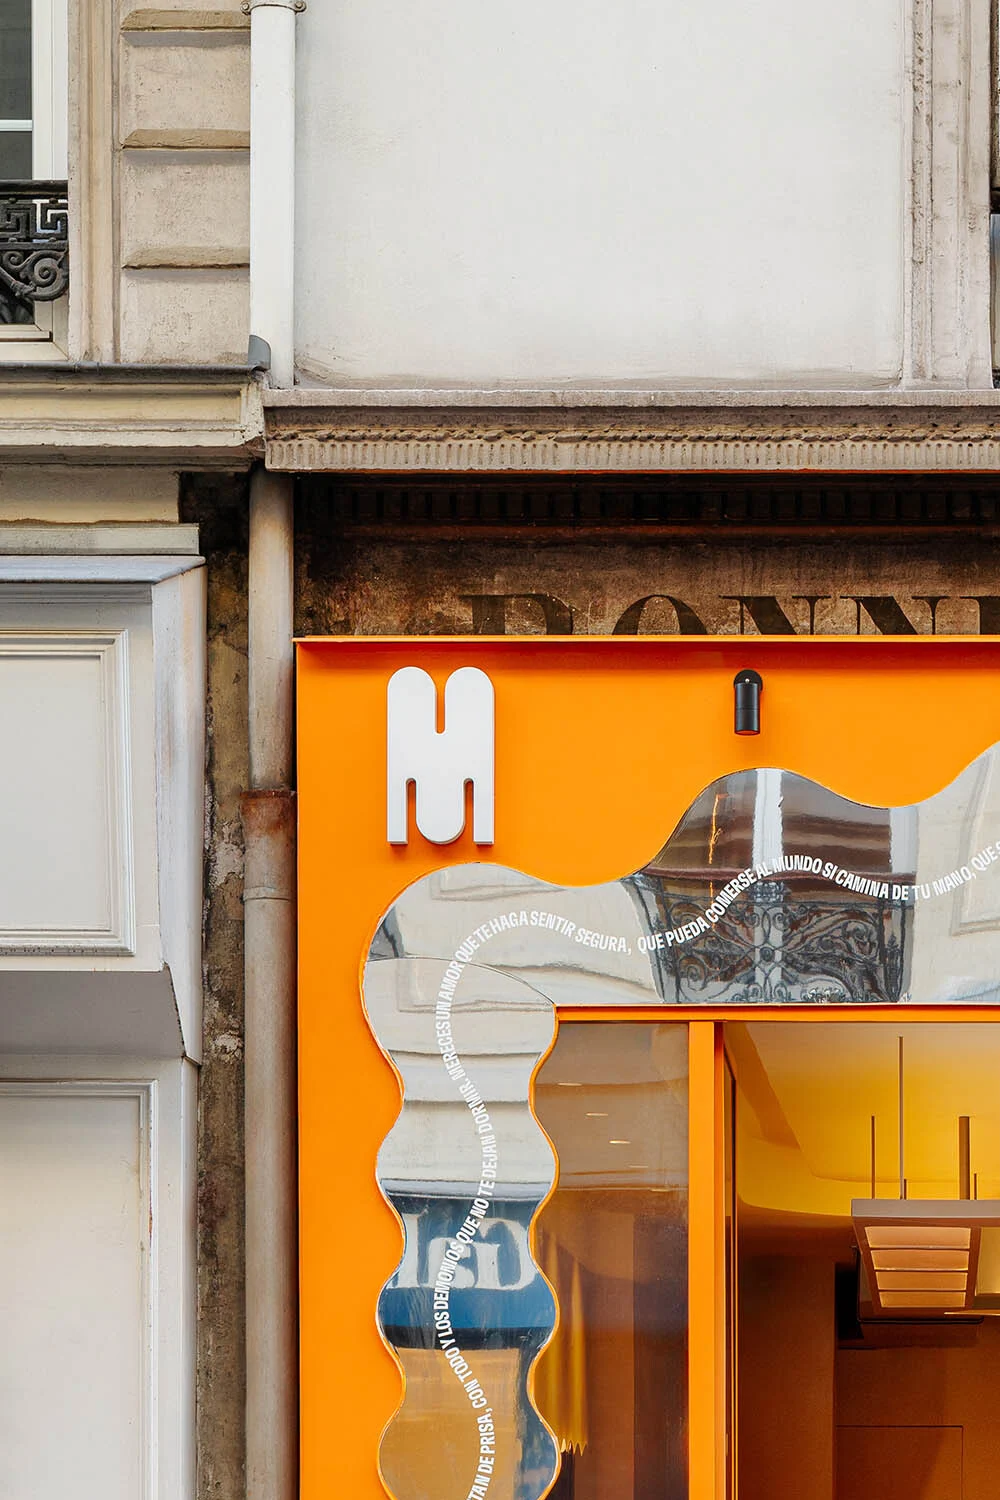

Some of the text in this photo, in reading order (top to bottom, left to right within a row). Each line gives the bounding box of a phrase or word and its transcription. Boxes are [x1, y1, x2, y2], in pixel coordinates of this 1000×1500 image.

[755, 862, 773, 880] AL
[773, 855, 822, 874] MUNDO
[822, 862, 840, 880] SI
[971, 846, 998, 872] QUE
[835, 869, 889, 899] CAMINA
[892, 885, 909, 901] DE
[911, 883, 931, 900] TU
[933, 866, 977, 897] MANO,
[705, 868, 758, 923] COMERSE
[472, 924, 494, 944] TE
[488, 910, 529, 934] HAGA
[530, 910, 577, 938] SENTIR
[665, 916, 711, 947] PUEDA
[455, 936, 480, 963] QUE
[575, 928, 632, 955] SEGURA,
[638, 933, 666, 954] QUE
[438, 960, 465, 1001] AMOR
[436, 1000, 450, 1021] UN
[436, 1021, 466, 1081] MERECES
[459, 1078, 495, 1134] DORMIR.
[480, 1134, 497, 1179] DEJAN
[477, 1179, 495, 1197] TE
[470, 1198, 490, 1221] NO
[455, 1215, 481, 1245] QUE
[433, 1241, 464, 1310] DEMONIOS
[434, 1311, 453, 1339] LOS
[439, 1338, 456, 1350] Y
[444, 1346, 473, 1383] TODO
[463, 1378, 487, 1409] CON
[477, 1408, 496, 1454] PRISA,
[477, 1456, 495, 1474] DE
